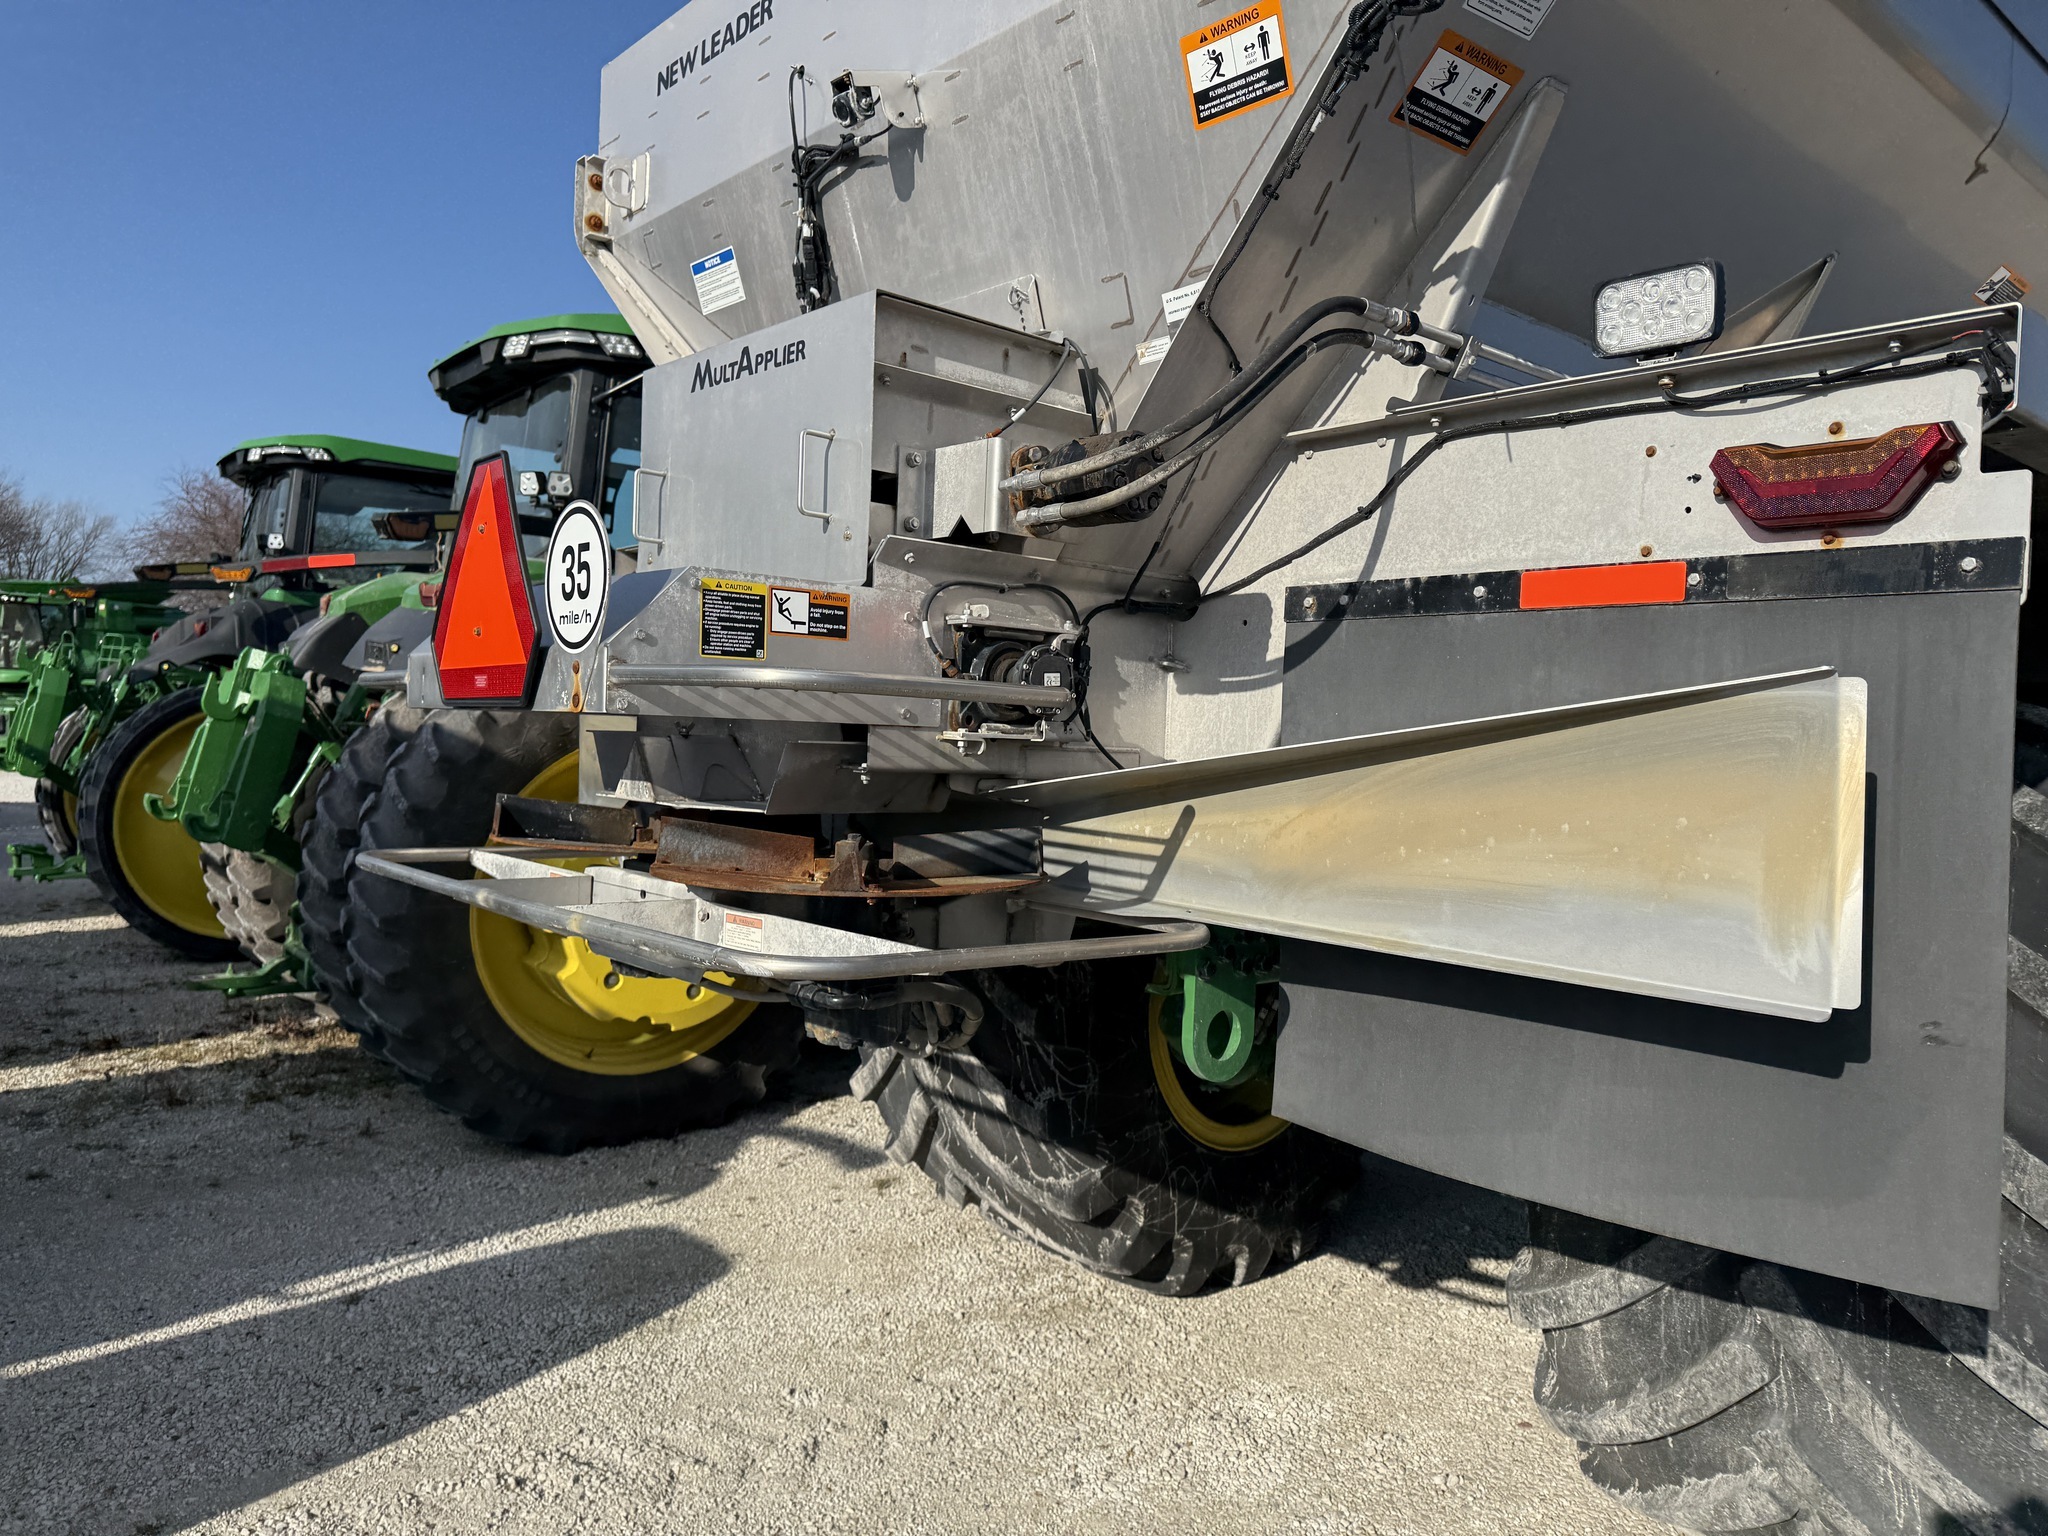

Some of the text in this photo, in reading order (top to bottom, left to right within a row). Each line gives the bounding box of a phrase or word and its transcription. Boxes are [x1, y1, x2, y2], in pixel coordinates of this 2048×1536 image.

[1210, 8, 1259, 37] WARNING
[657, 0, 773, 96] NEW LEADER
[1245, 51, 1256, 59] KEEP
[1466, 45, 1508, 75] WARNING
[1209, 68, 1269, 98] FLYING DEBRIS HAZARD!
[1200, 109, 1211, 118] STAY
[1226, 96, 1245, 108] OBJECTS
[1246, 91, 1255, 100] CAN
[1205, 98, 1220, 109] prevent
[1221, 93, 1235, 102] serious
[1236, 87, 1248, 97] injury
[1410, 103, 1424, 114] prevent
[1424, 110, 1437, 120] serious
[1437, 116, 1447, 126] injury
[1421, 97, 1471, 126] FLYING DEBRIS HAZARD!
[1423, 119, 1440, 131] OBJECTS
[1440, 126, 1448, 134] CAN
[1447, 129, 1454, 137] BE
[704, 256, 721, 269] NOTICE
[561, 542, 591, 601] 35
[725, 583, 752, 591] CAUTION
[559, 609, 592, 625] mile/h
